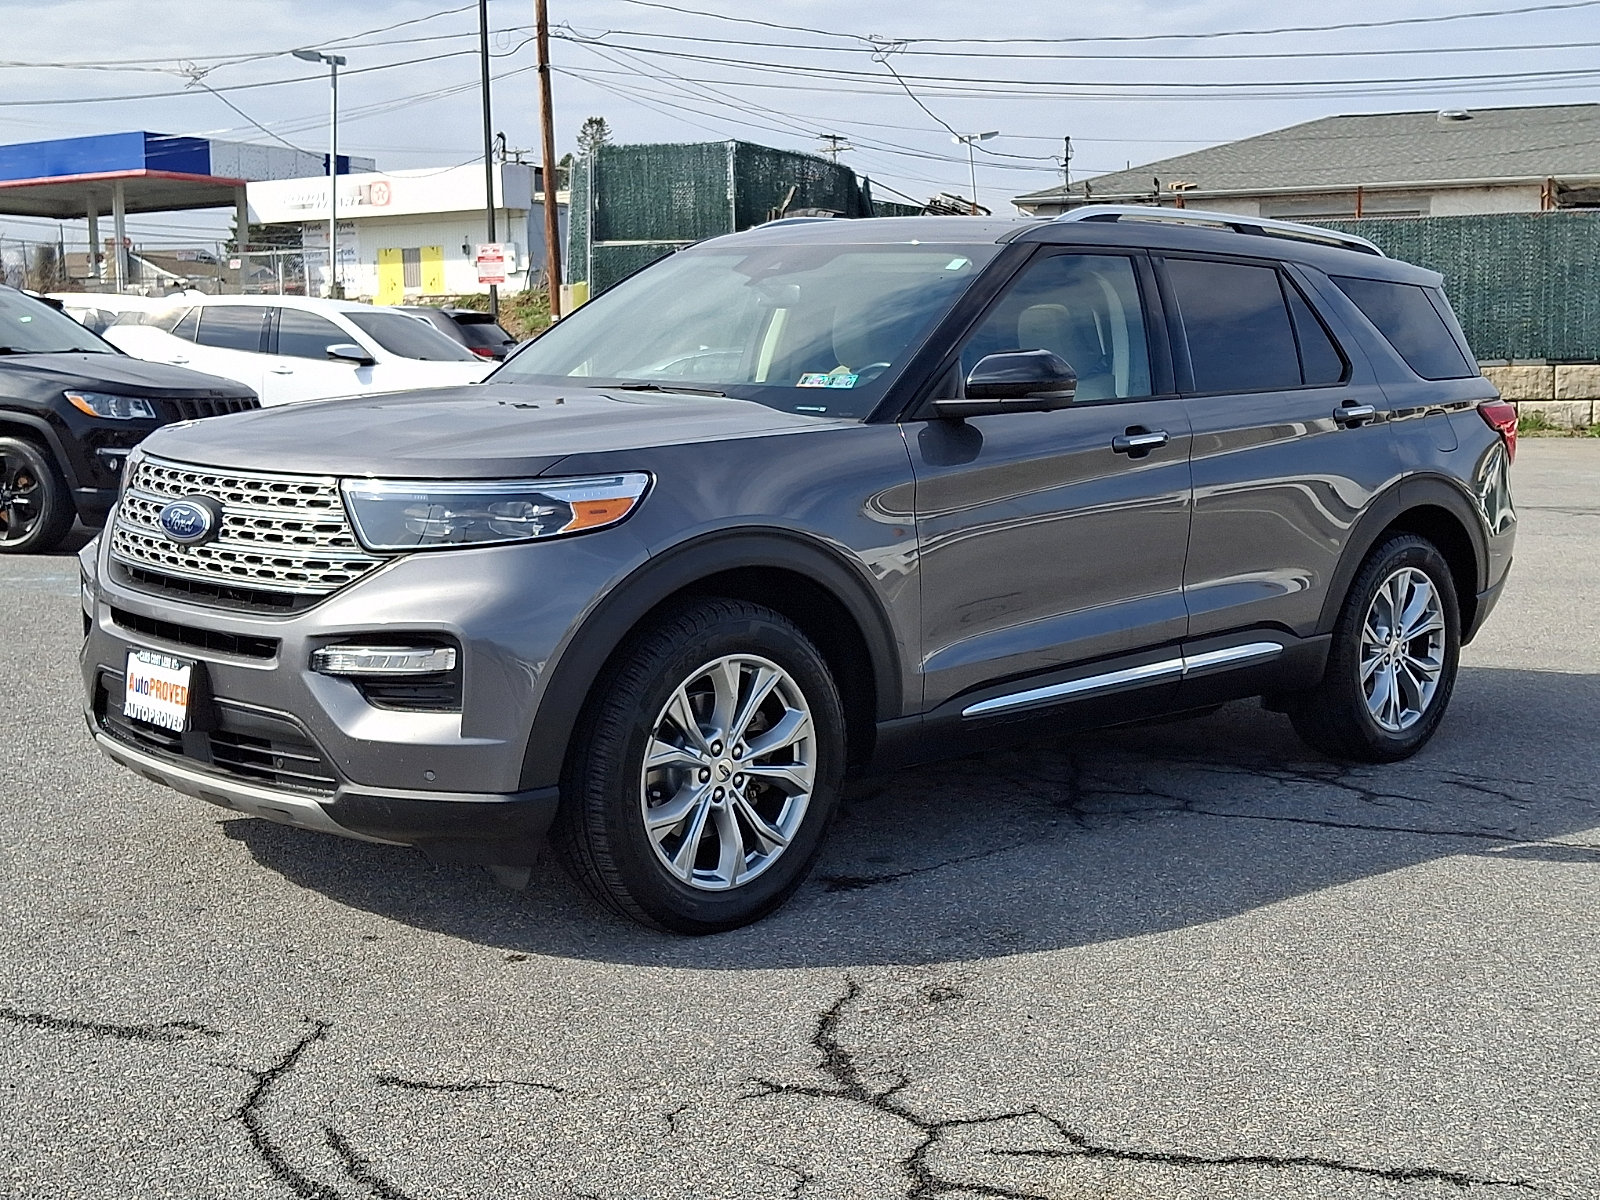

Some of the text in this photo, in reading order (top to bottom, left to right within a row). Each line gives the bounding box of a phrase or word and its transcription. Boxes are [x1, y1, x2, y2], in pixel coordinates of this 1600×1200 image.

[304, 223, 323, 233] Tyvek
[336, 221, 355, 232] Tyvek
[165, 508, 196, 533] Ford
[128, 672, 188, 707] AutoPROVED
[123, 701, 185, 733] AUTOPROVED
